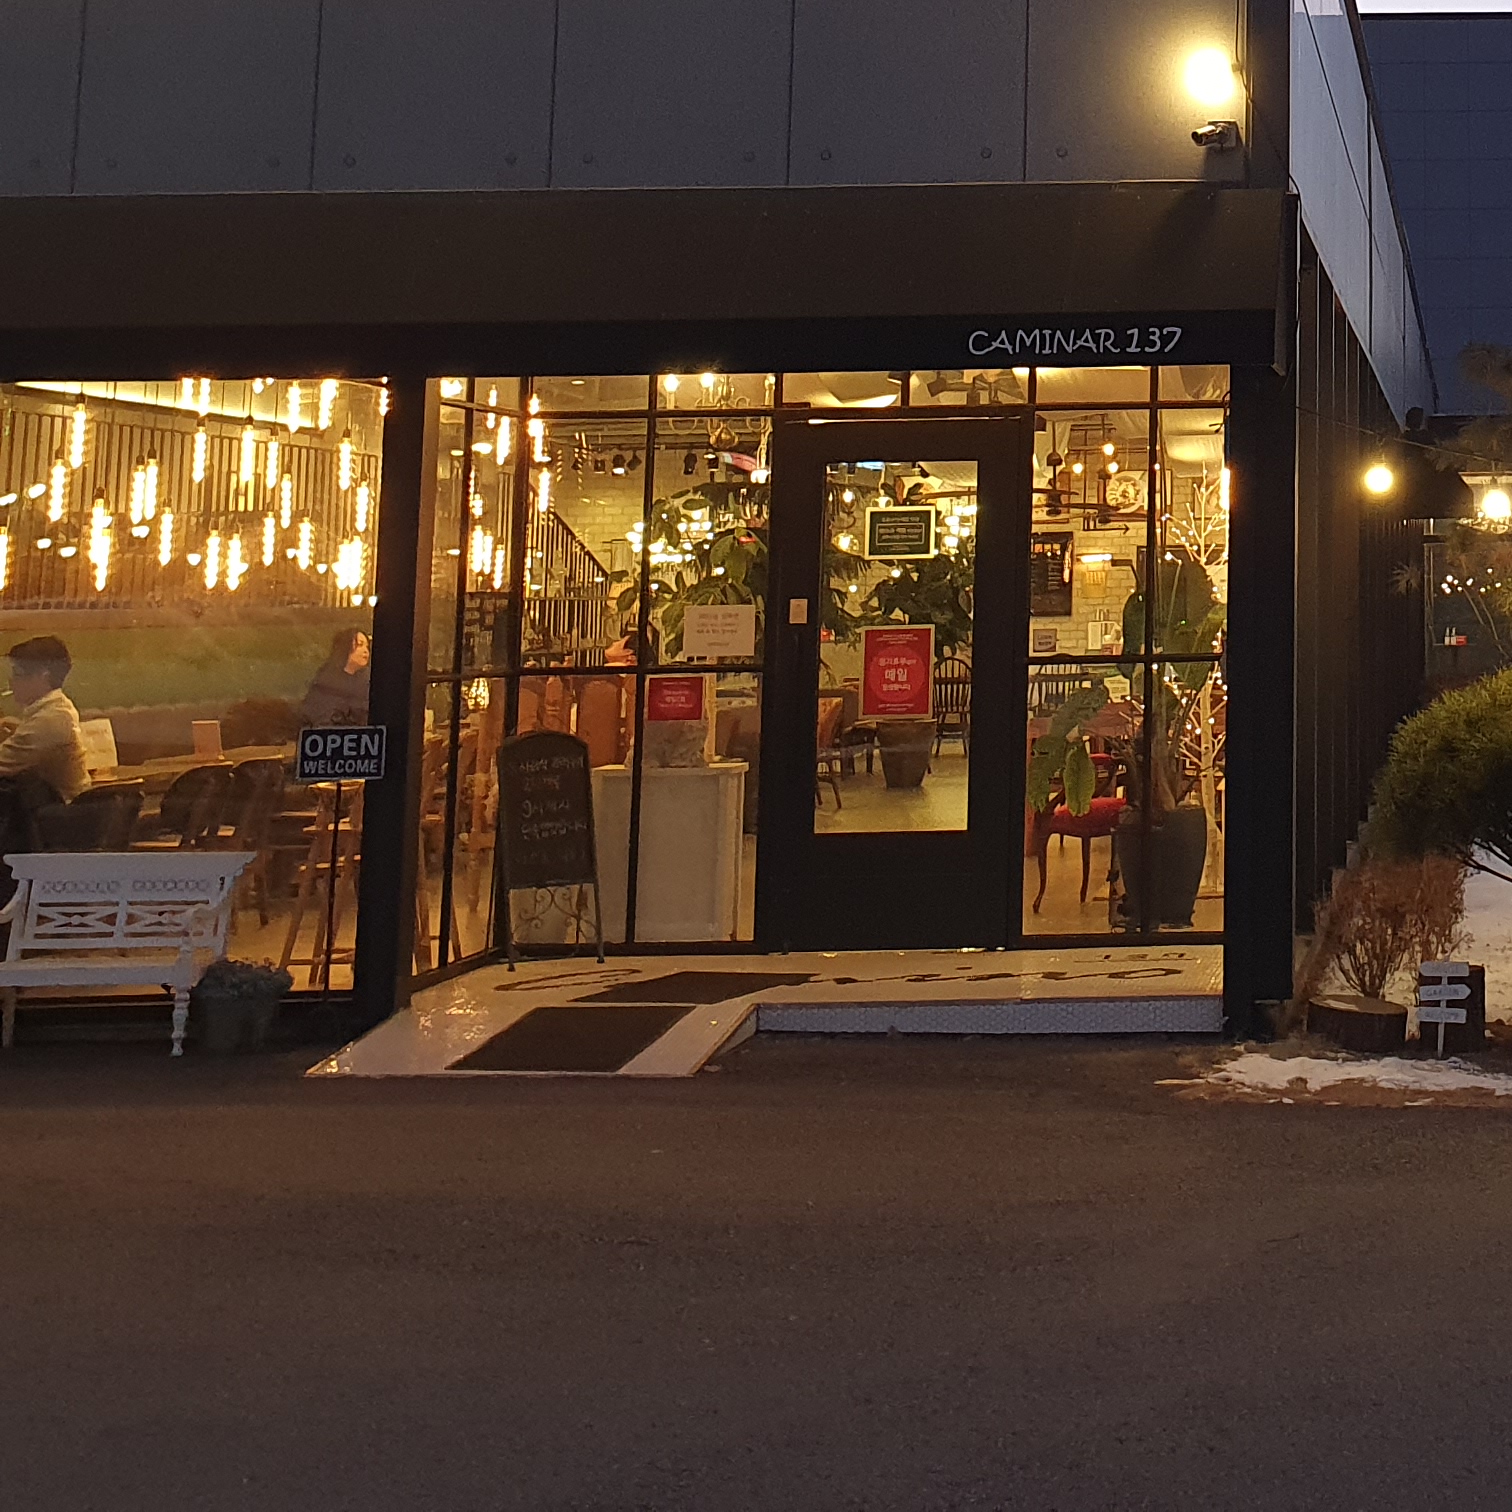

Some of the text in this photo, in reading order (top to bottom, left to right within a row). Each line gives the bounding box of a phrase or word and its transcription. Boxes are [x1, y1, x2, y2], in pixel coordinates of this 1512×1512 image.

[968, 326, 1183, 356] CAMINAR 137
[304, 733, 380, 757] OPEN
[303, 758, 379, 774] WELCOME
